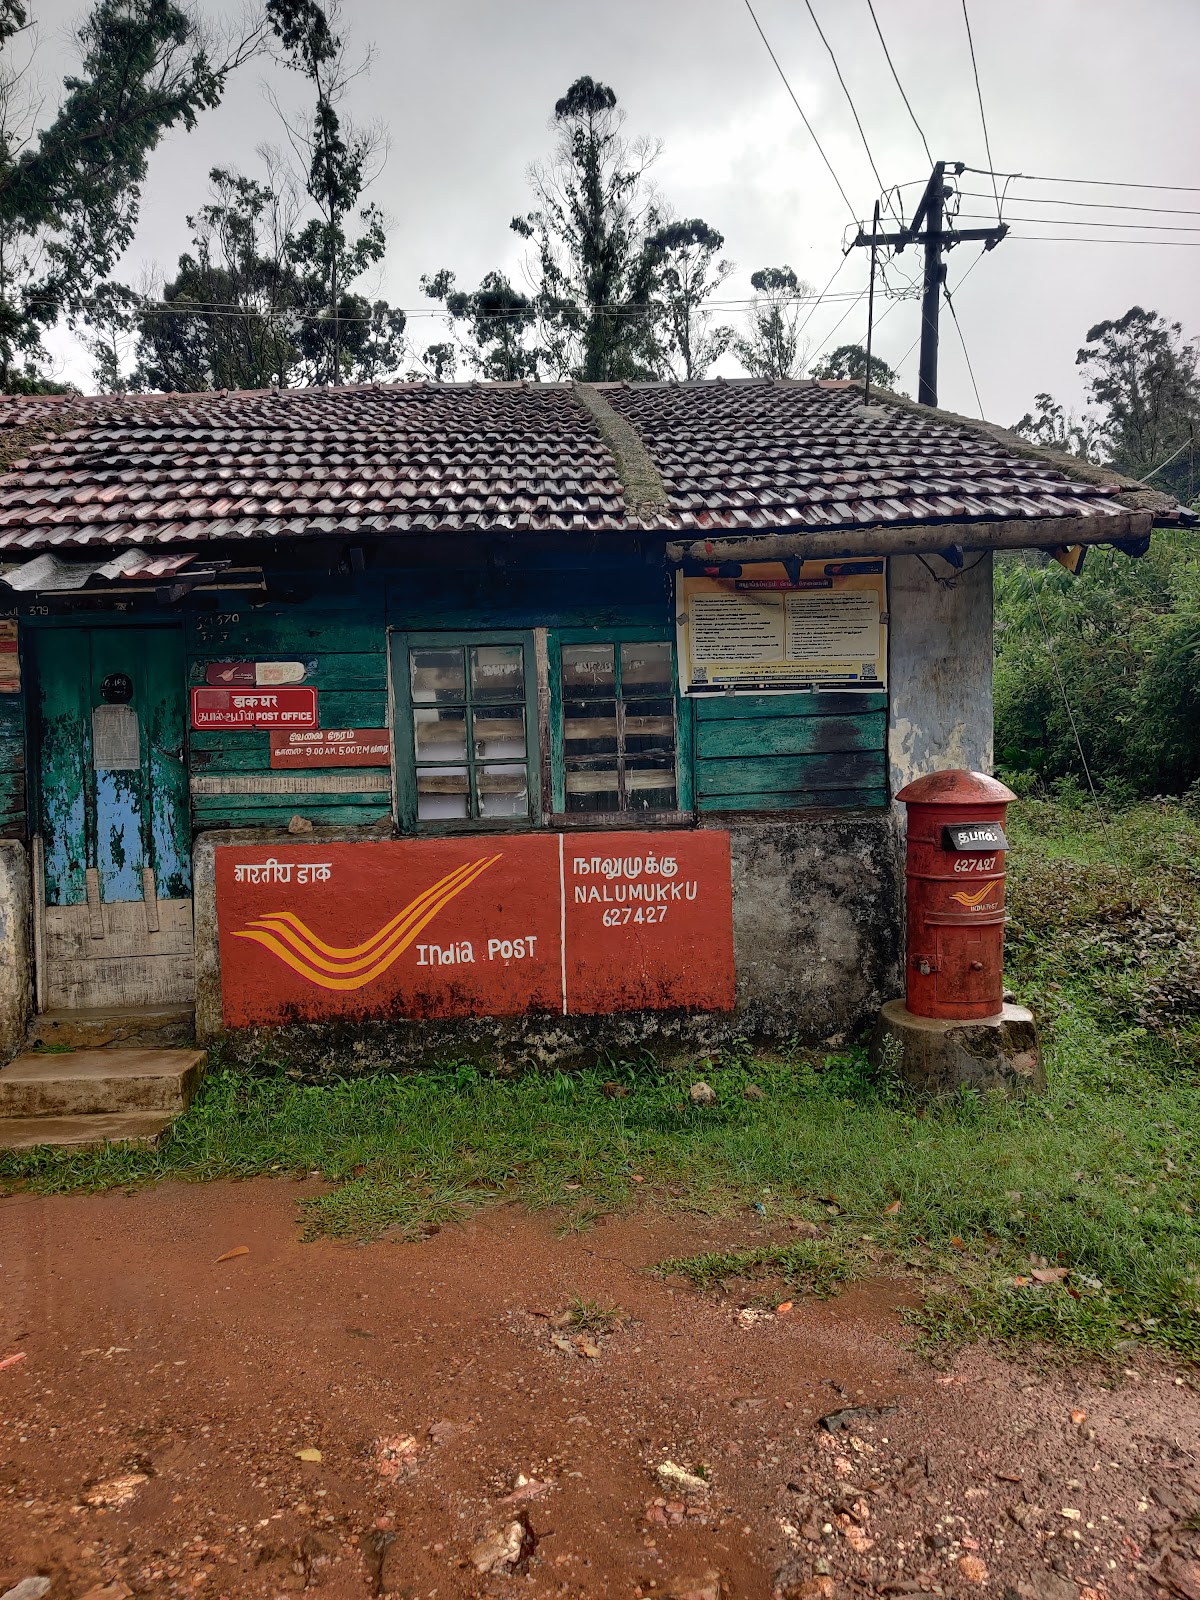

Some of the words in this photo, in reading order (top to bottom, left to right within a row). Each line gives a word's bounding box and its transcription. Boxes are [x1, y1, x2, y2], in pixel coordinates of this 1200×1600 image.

[256, 711, 279, 721] POST
[281, 711, 312, 721] OFFICE
[289, 732, 323, 742] வேலை
[327, 729, 355, 742] நேரம்
[305, 747, 324, 756] 9.00
[338, 746, 356, 755] 5.00
[957, 829, 998, 845] தபால்
[234, 857, 295, 884] भारतीय
[297, 863, 333, 884] डाक
[573, 850, 678, 880] நாலுமுக்கு
[953, 857, 996, 873] 627427
[574, 881, 698, 903] NALUMUKKU
[602, 905, 668, 927] 627427
[416, 941, 475, 966] India
